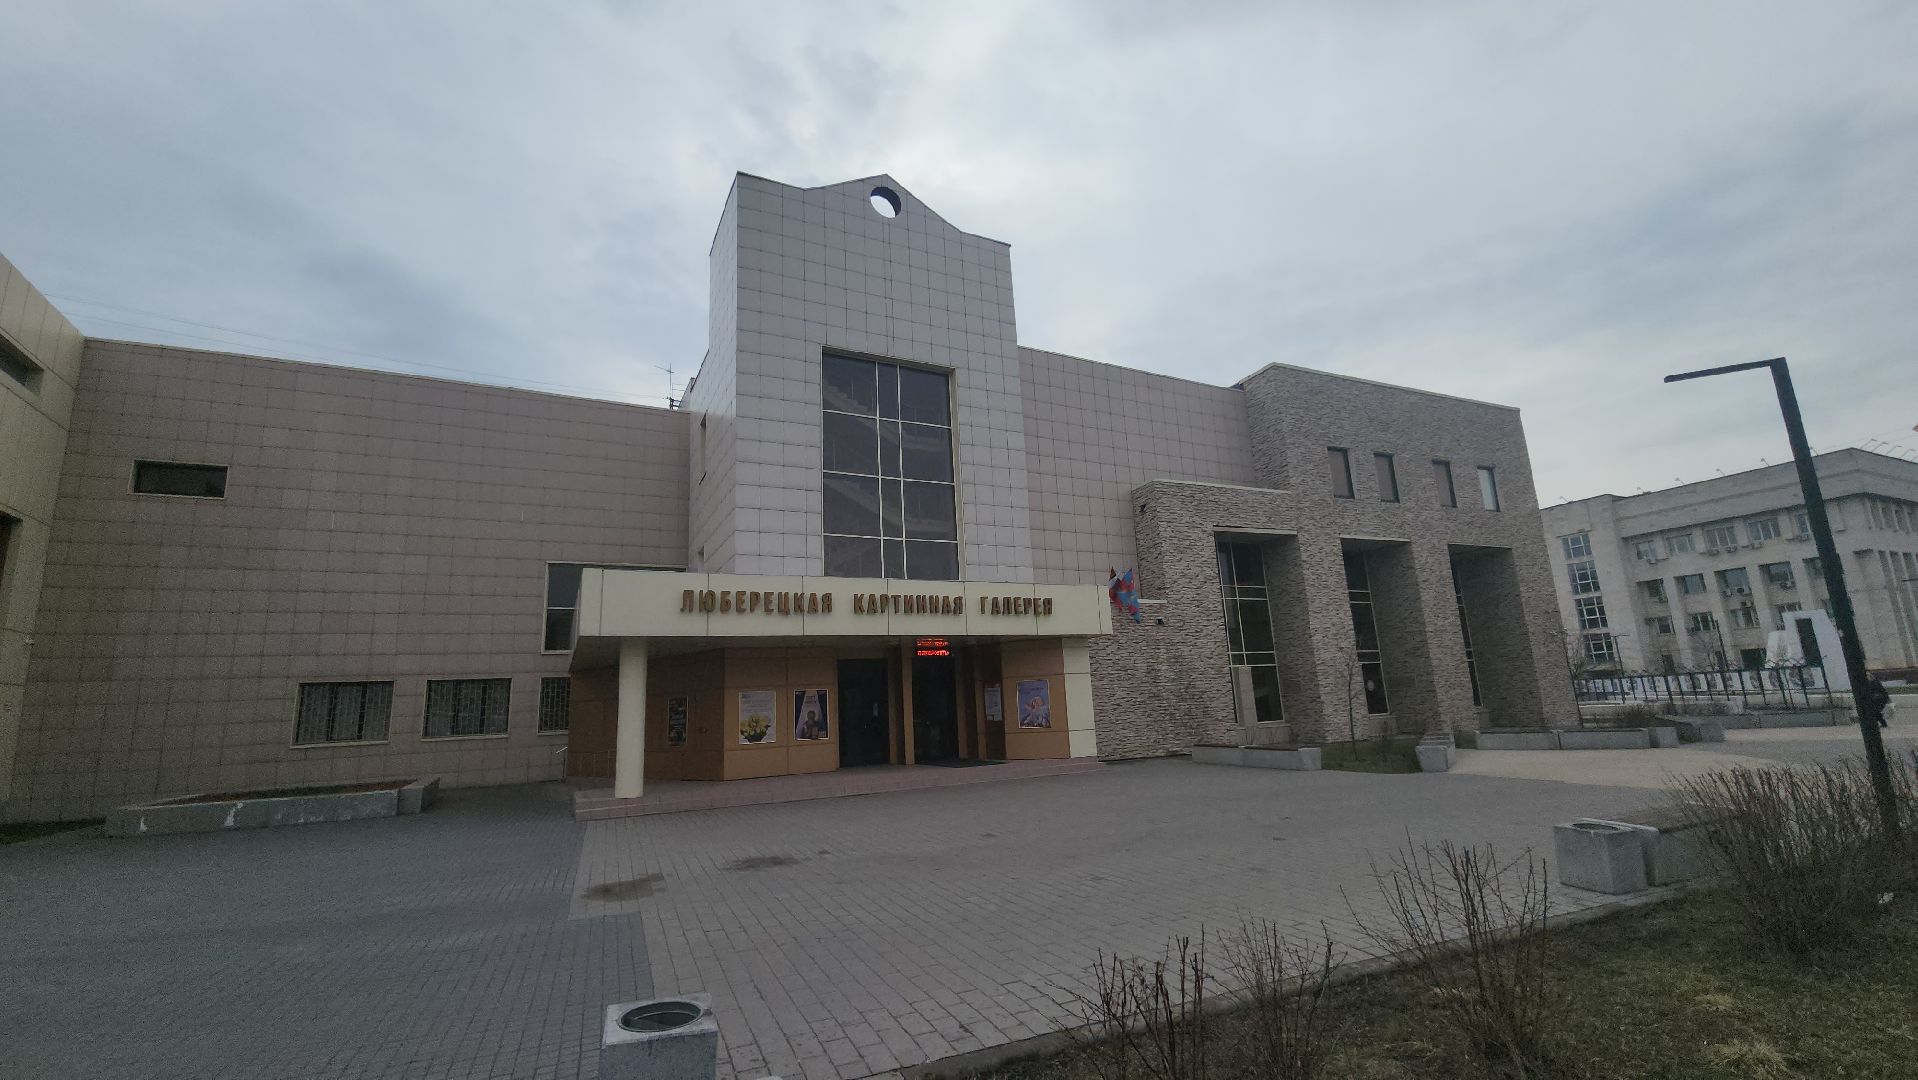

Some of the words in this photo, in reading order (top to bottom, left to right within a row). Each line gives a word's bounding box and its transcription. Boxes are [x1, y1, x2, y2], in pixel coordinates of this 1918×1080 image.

[680, 590, 833, 616] ЛЮБЕРЕЦКАЯ
[853, 593, 964, 616] КАРТИННАЯ
[980, 596, 1053, 616] ГАЛЕРЕЯ
